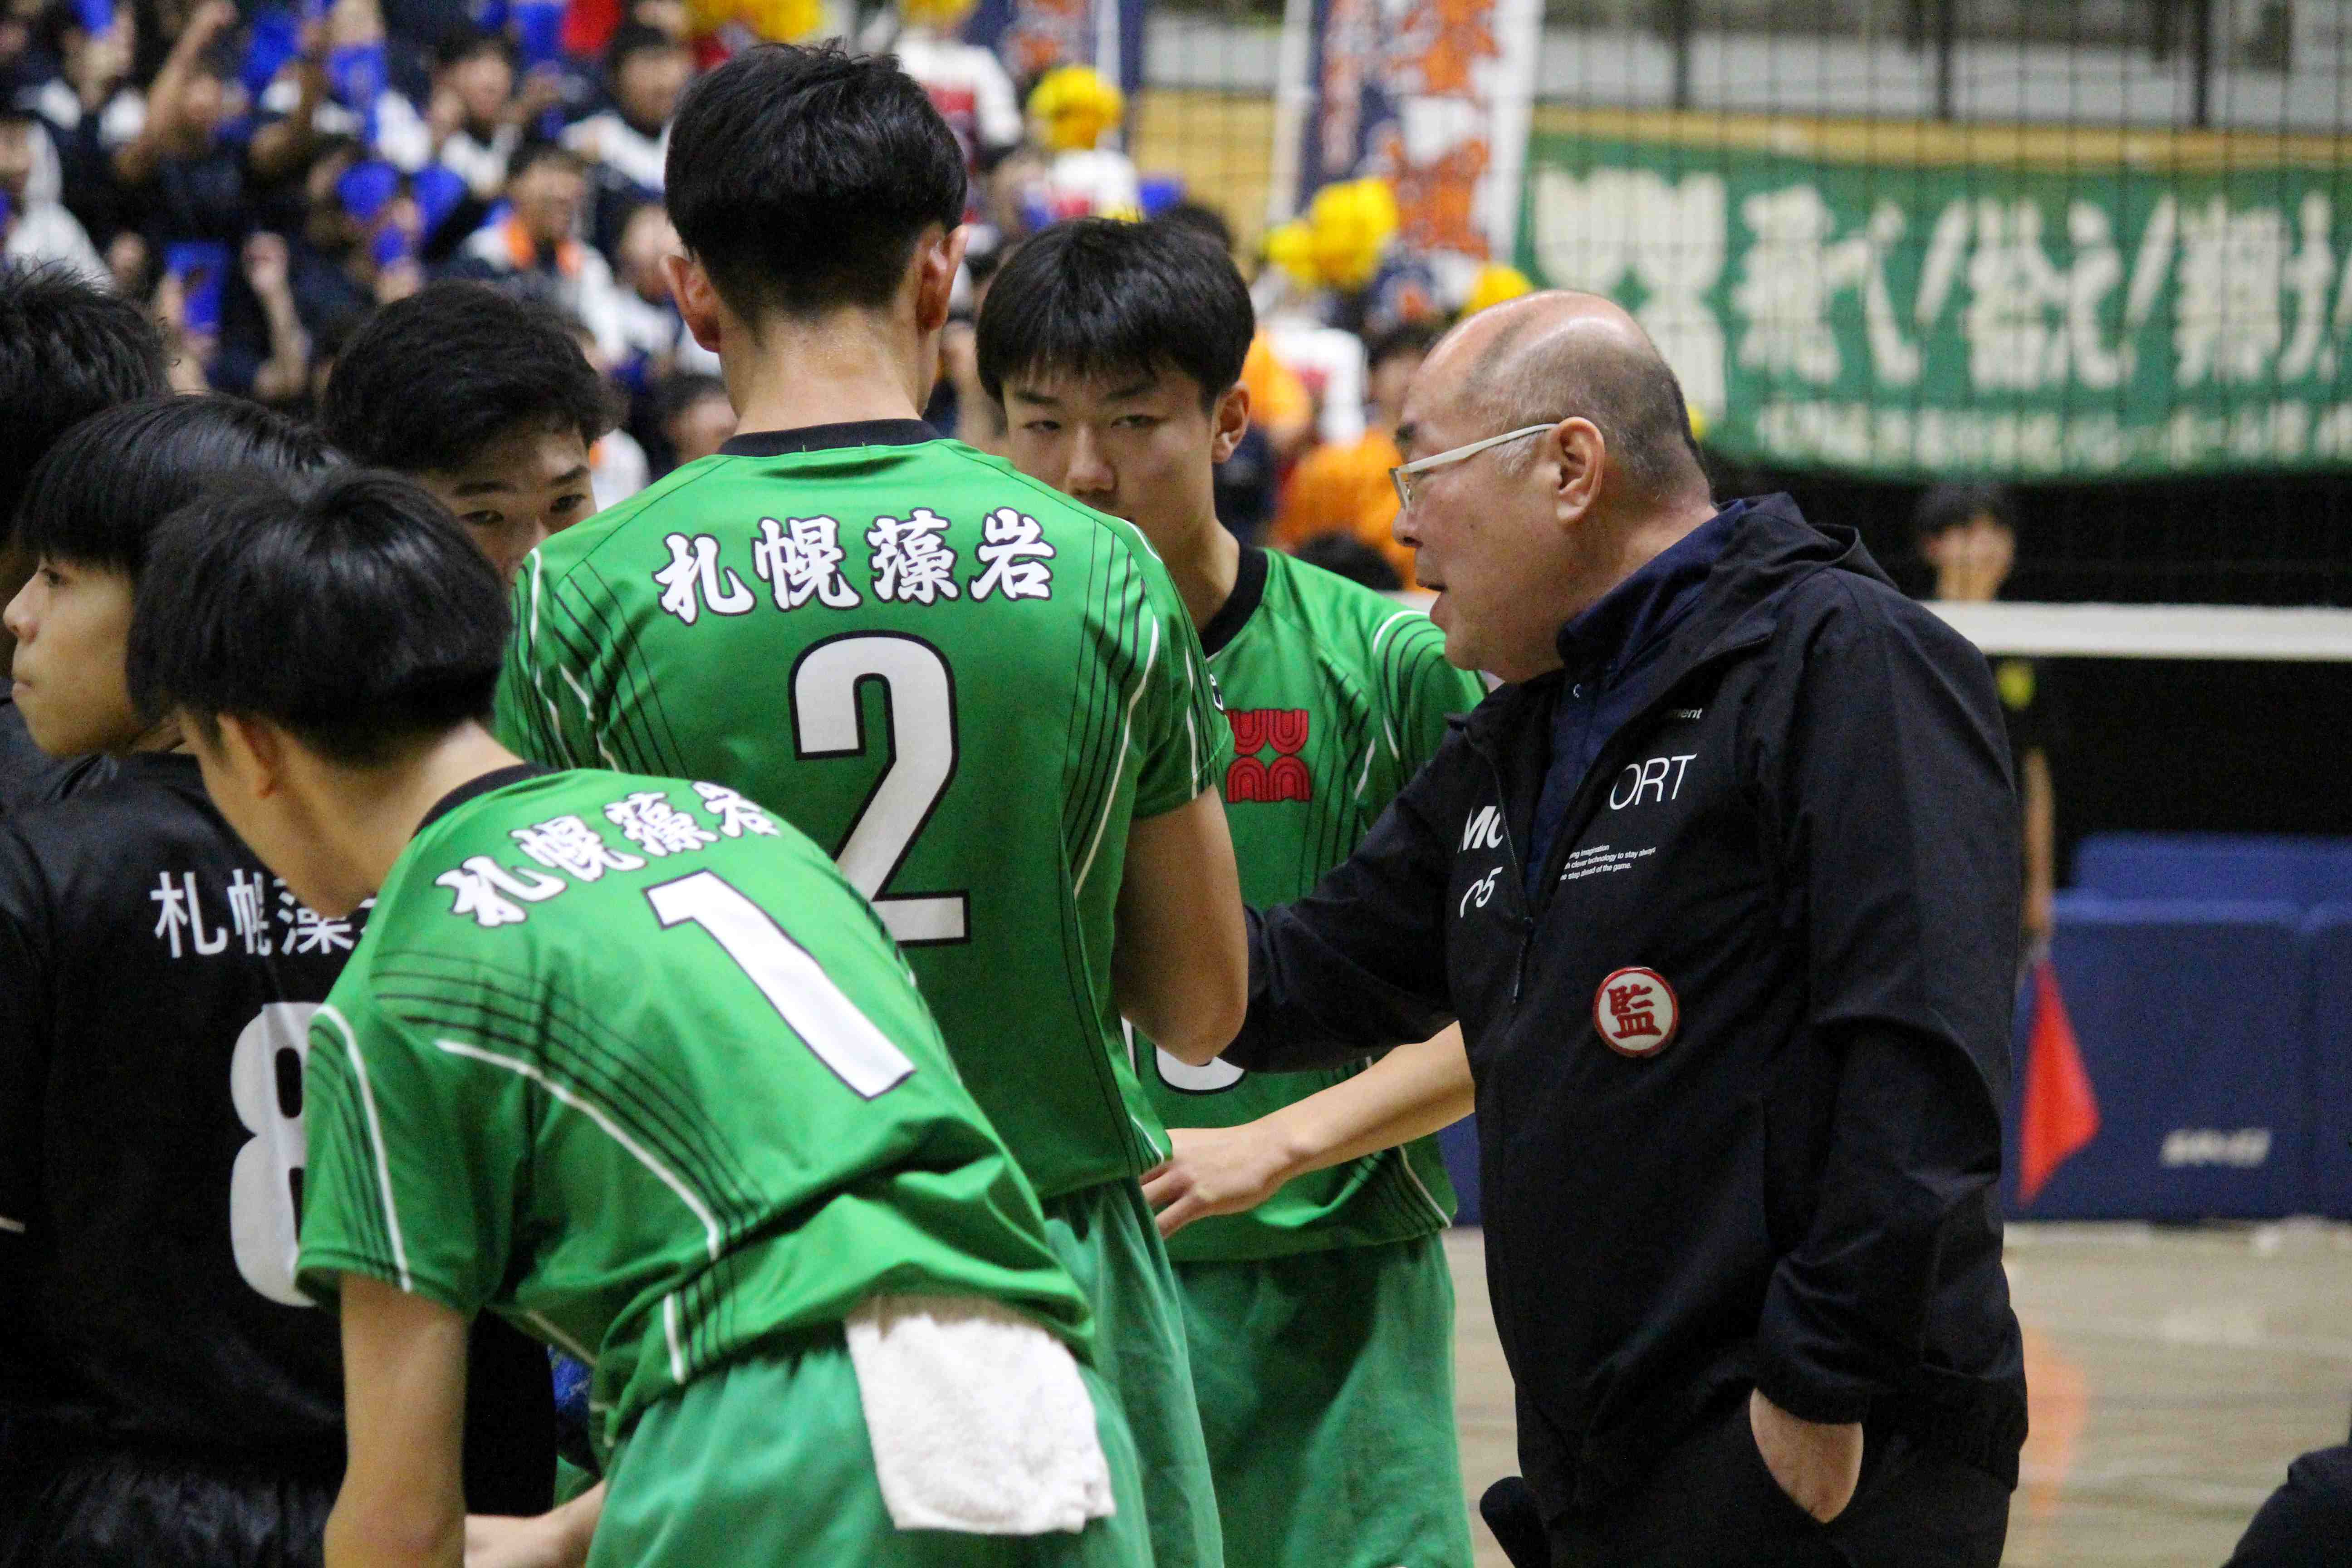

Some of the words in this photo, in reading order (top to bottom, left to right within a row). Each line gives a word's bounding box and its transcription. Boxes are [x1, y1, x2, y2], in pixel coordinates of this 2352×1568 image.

[653, 507, 1056, 626] 札幌藻岩
[788, 629, 970, 948] 2
[1610, 753, 1697, 810] ORT
[435, 781, 781, 926] 札幌藻岩
[1596, 865, 1602, 873] of
[643, 868, 916, 1101] 1
[1607, 984, 1662, 1039] 監
[230, 1002, 326, 1307] 8
